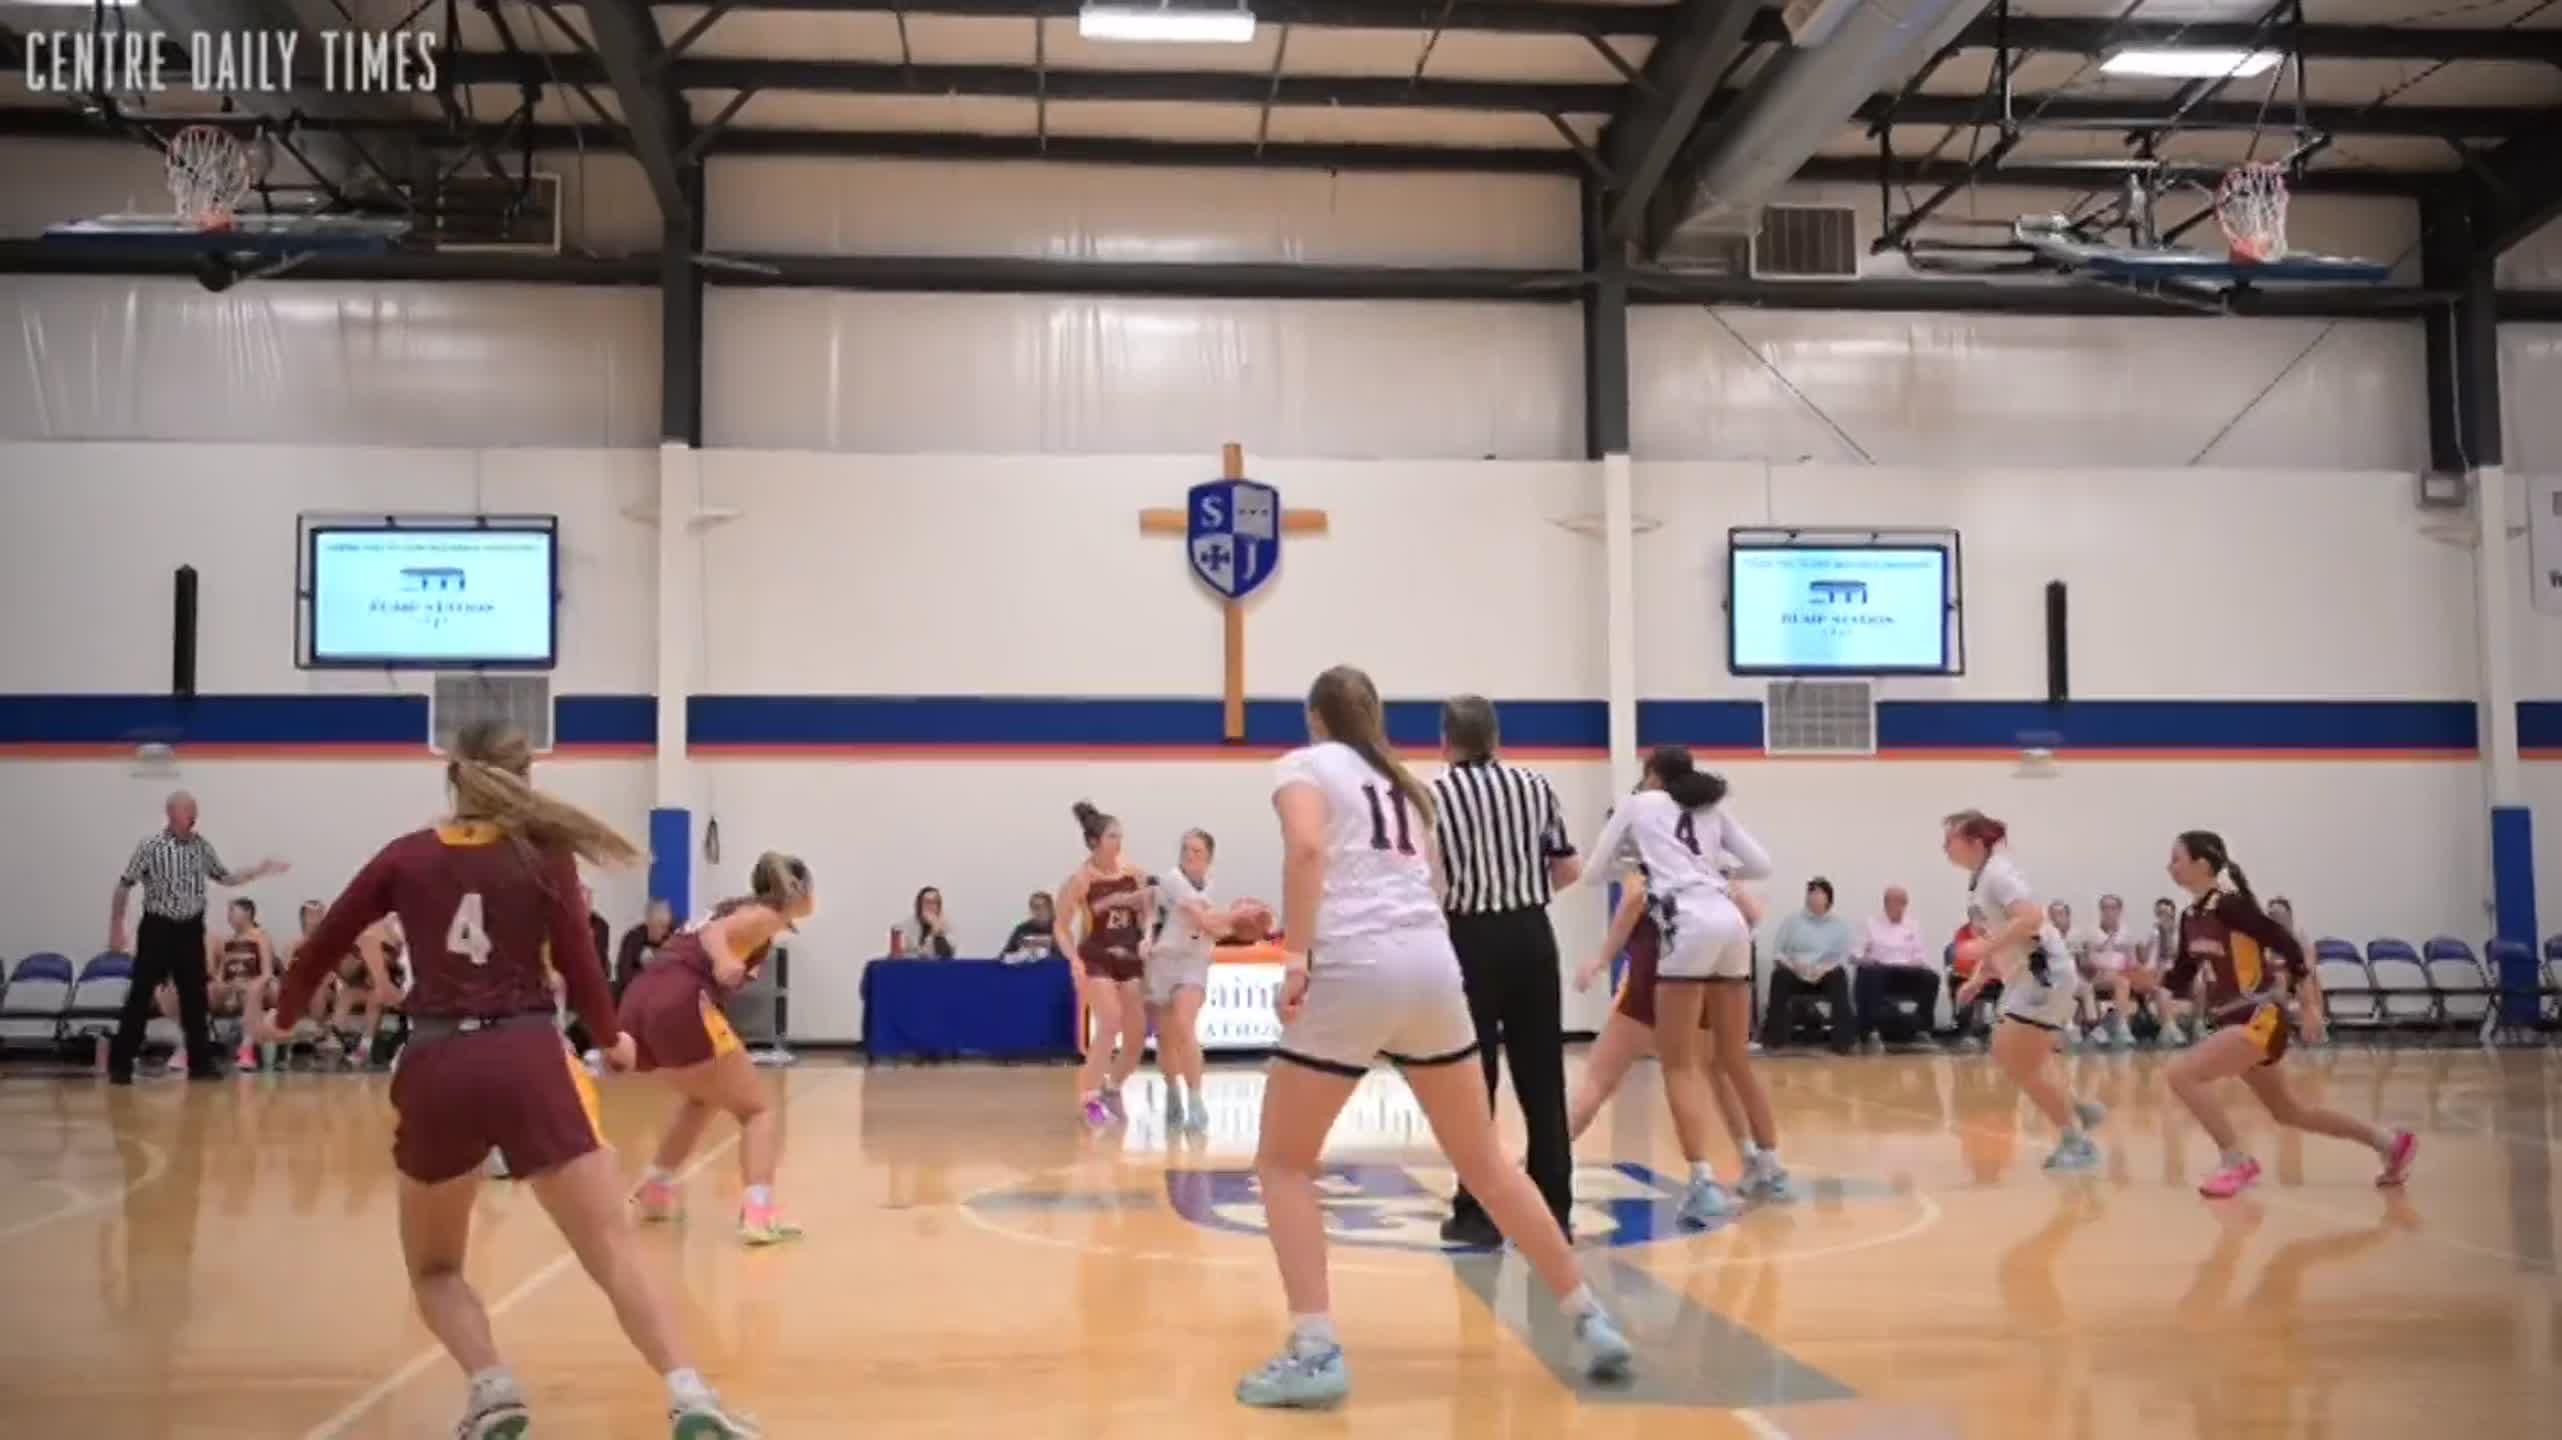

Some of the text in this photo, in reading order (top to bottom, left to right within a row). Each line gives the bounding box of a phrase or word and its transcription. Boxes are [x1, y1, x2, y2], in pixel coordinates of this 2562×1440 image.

[1201, 496, 1223, 529] S
[1242, 540, 1257, 580] J
[1362, 783, 1416, 857] 11
[1675, 810, 1703, 856] 4
[447, 893, 491, 965] 4
